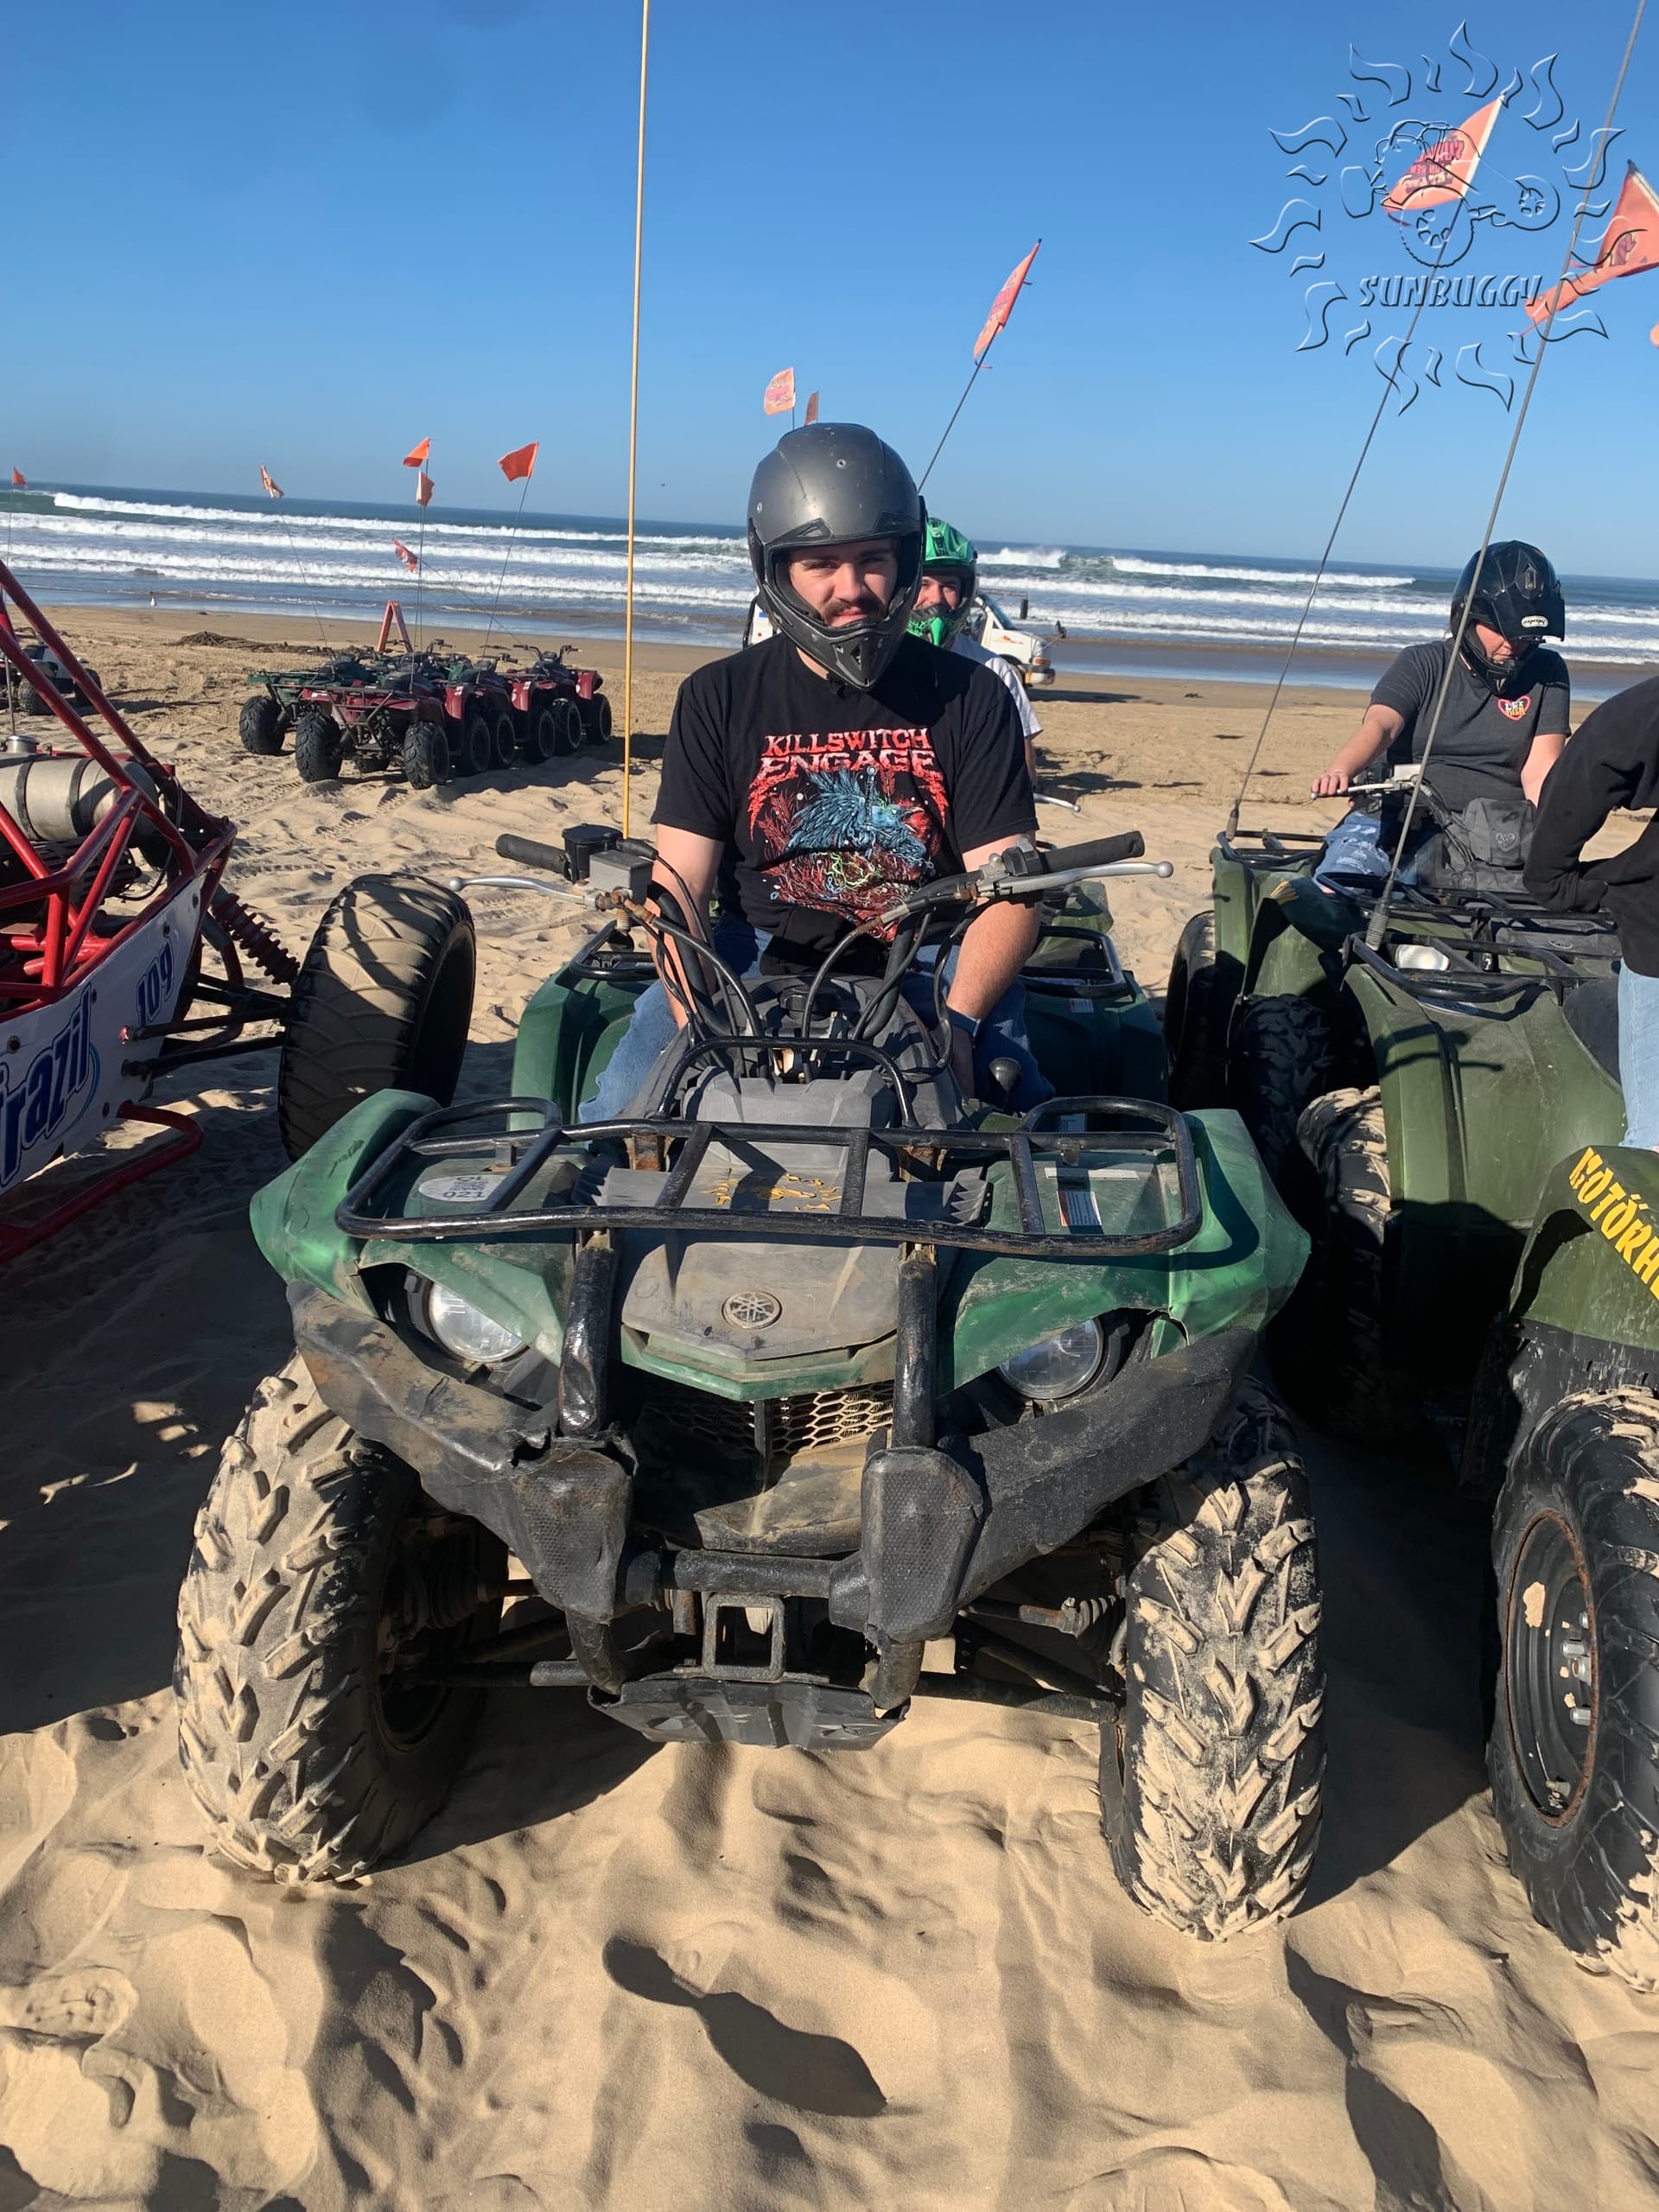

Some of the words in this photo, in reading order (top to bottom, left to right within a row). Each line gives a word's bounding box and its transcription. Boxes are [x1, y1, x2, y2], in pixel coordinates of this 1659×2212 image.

[764, 728, 932, 756] KILLSWITCH
[137, 939, 173, 1027] 109
[0, 983, 92, 1186] razil
